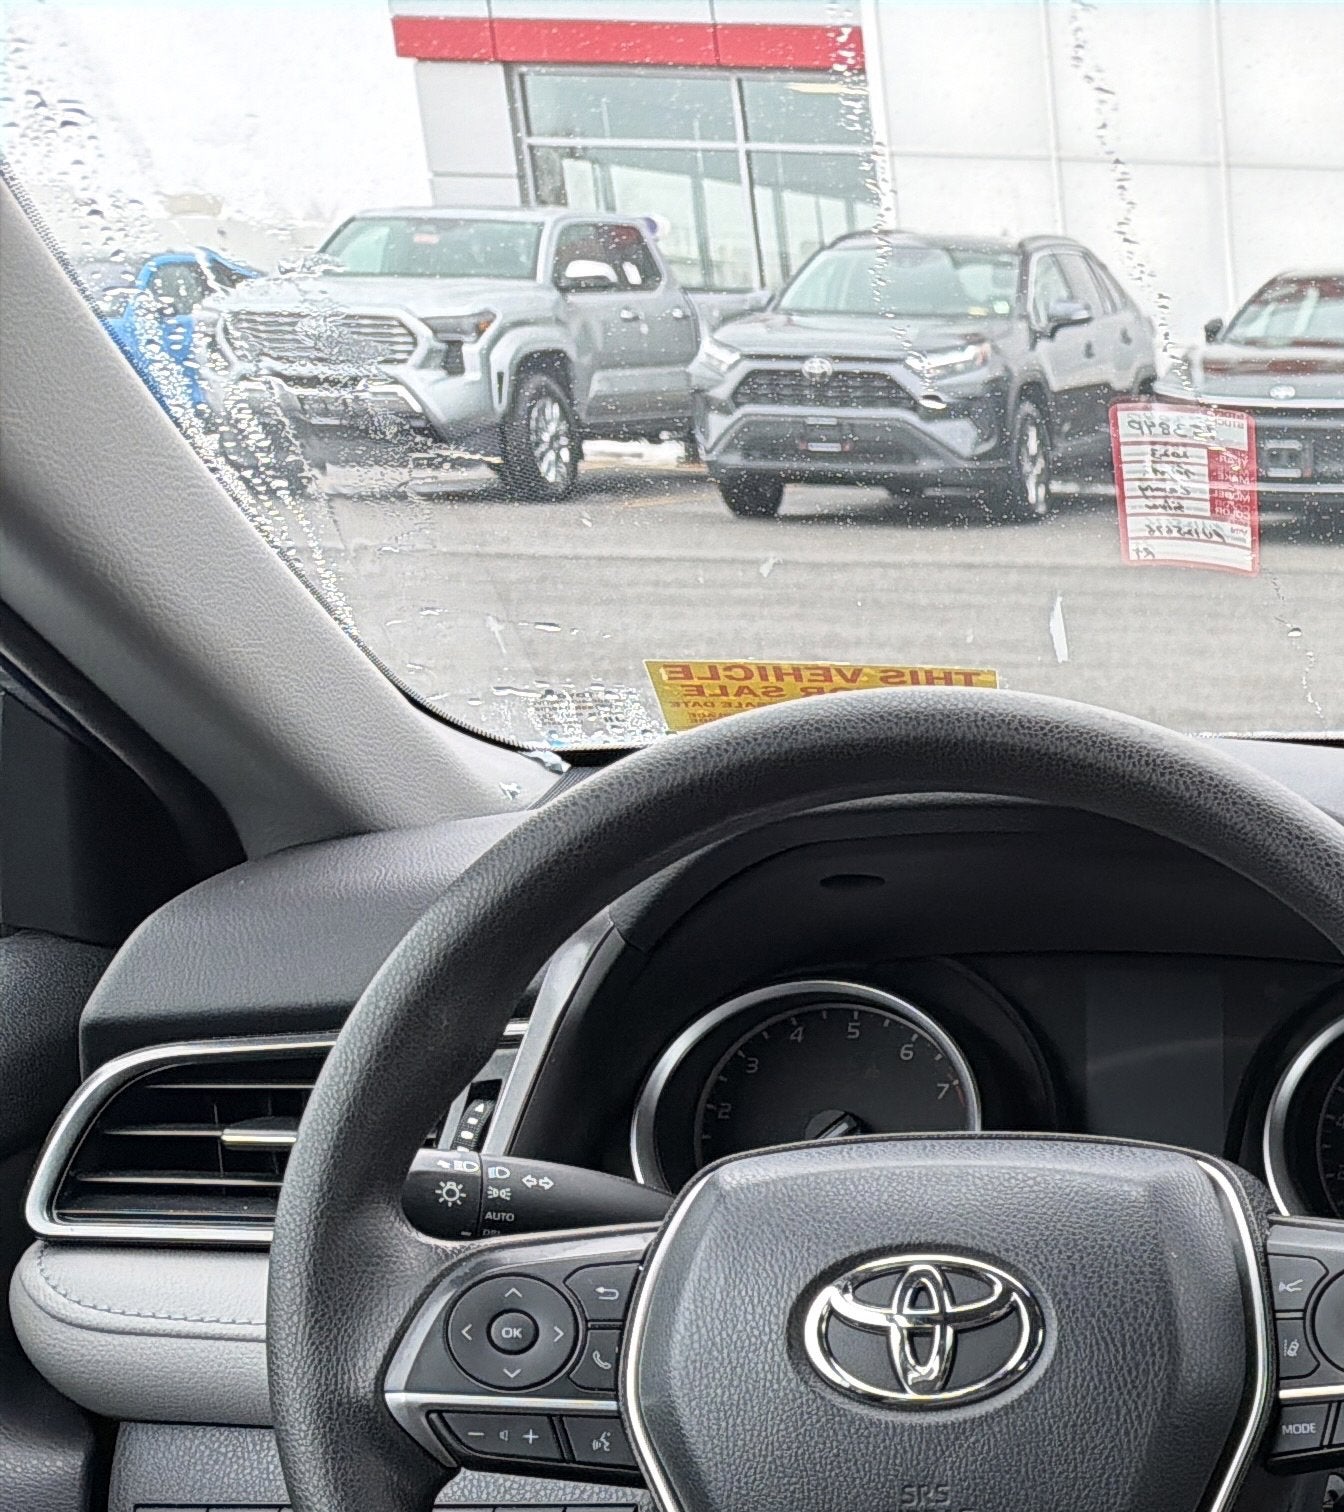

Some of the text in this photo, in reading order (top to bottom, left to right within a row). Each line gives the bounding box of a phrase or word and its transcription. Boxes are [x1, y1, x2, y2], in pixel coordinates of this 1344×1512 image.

[790, 1026, 804, 1042] 4
[848, 1022, 861, 1039] 5
[900, 1044, 914, 1061] 6
[746, 1057, 759, 1073] 3
[937, 1083, 950, 1099] 7
[717, 1103, 732, 1119] 2
[484, 1211, 515, 1222] AUTO
[501, 1327, 523, 1339] OK
[1282, 1422, 1316, 1435] MODE
[901, 1484, 950, 1507] SRS
